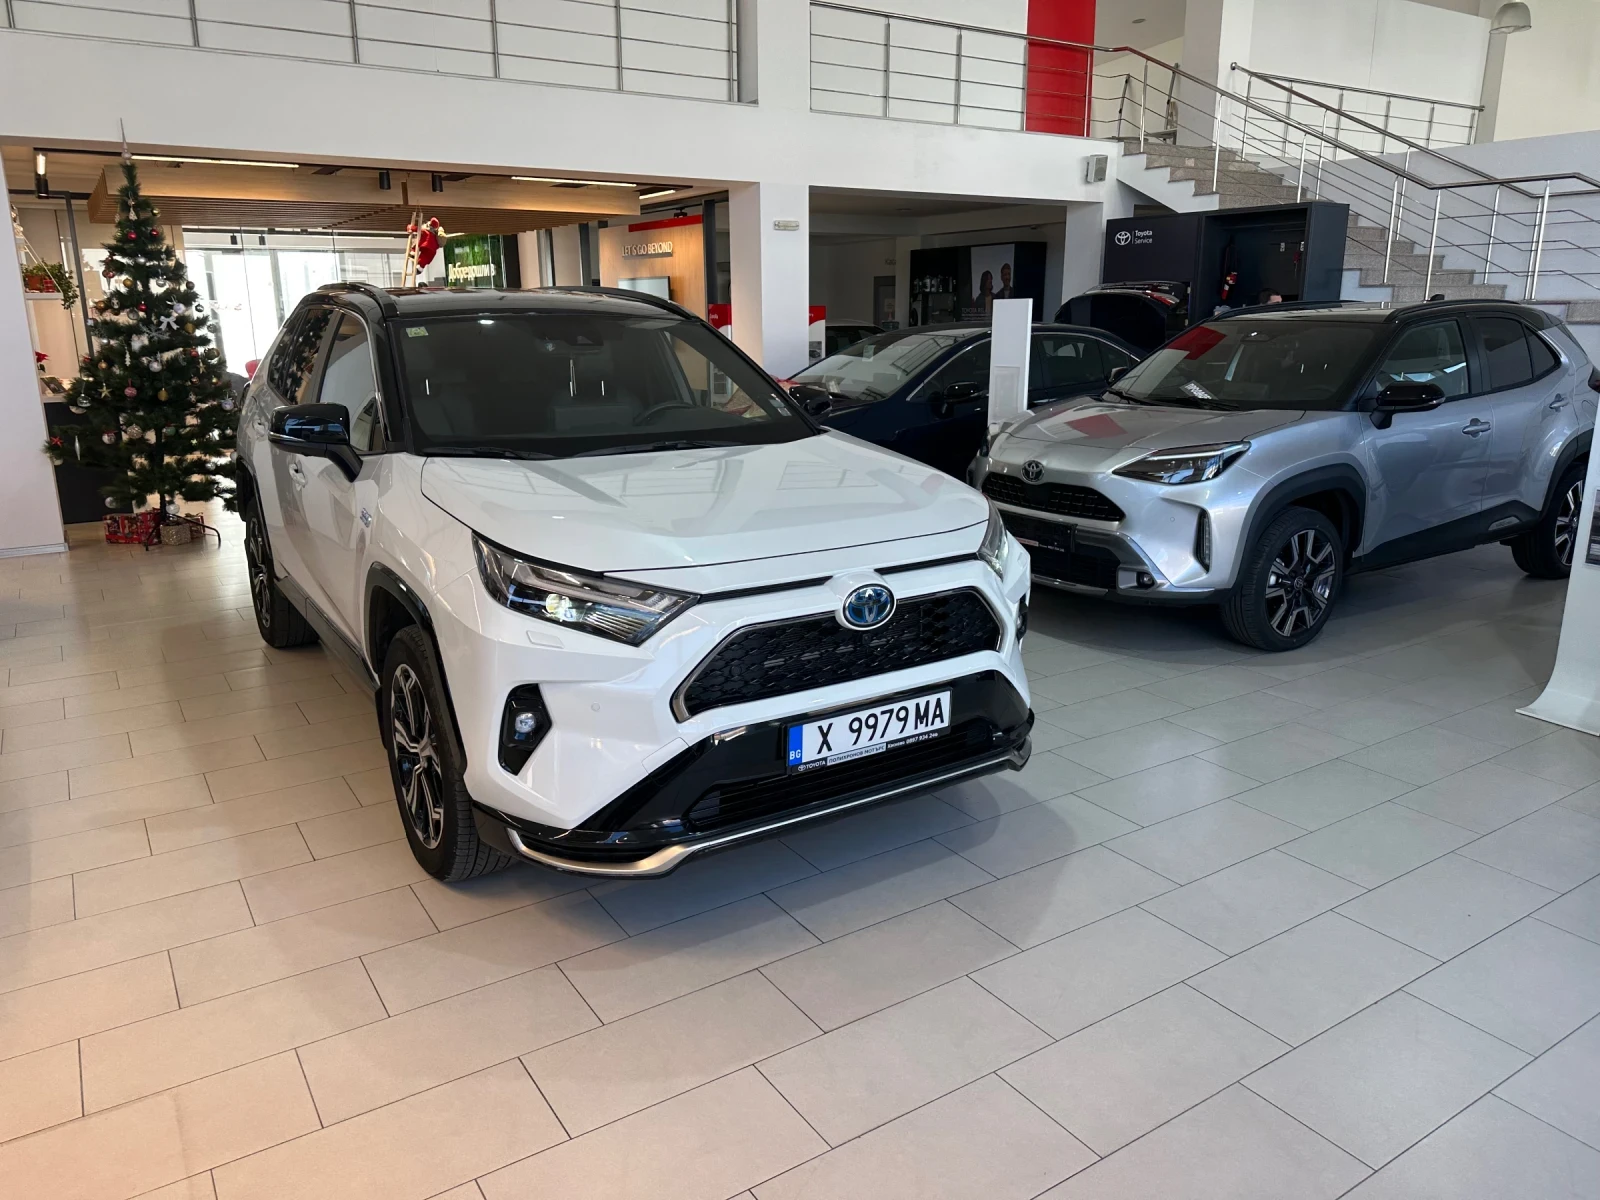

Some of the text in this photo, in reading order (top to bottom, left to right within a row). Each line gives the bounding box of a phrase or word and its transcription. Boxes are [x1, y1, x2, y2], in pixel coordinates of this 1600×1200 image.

[637, 244, 647, 255] GO
[648, 241, 673, 254] BEYOND
[448, 262, 490, 283] Добредошли
[848, 705, 909, 746] 9979
[914, 697, 945, 730] MA
[789, 749, 802, 760] BG
[806, 760, 826, 769] TOYOTA
[828, 750, 864, 764] ПОЛИХРОНОВ
[864, 745, 885, 755] МОТЪРС
